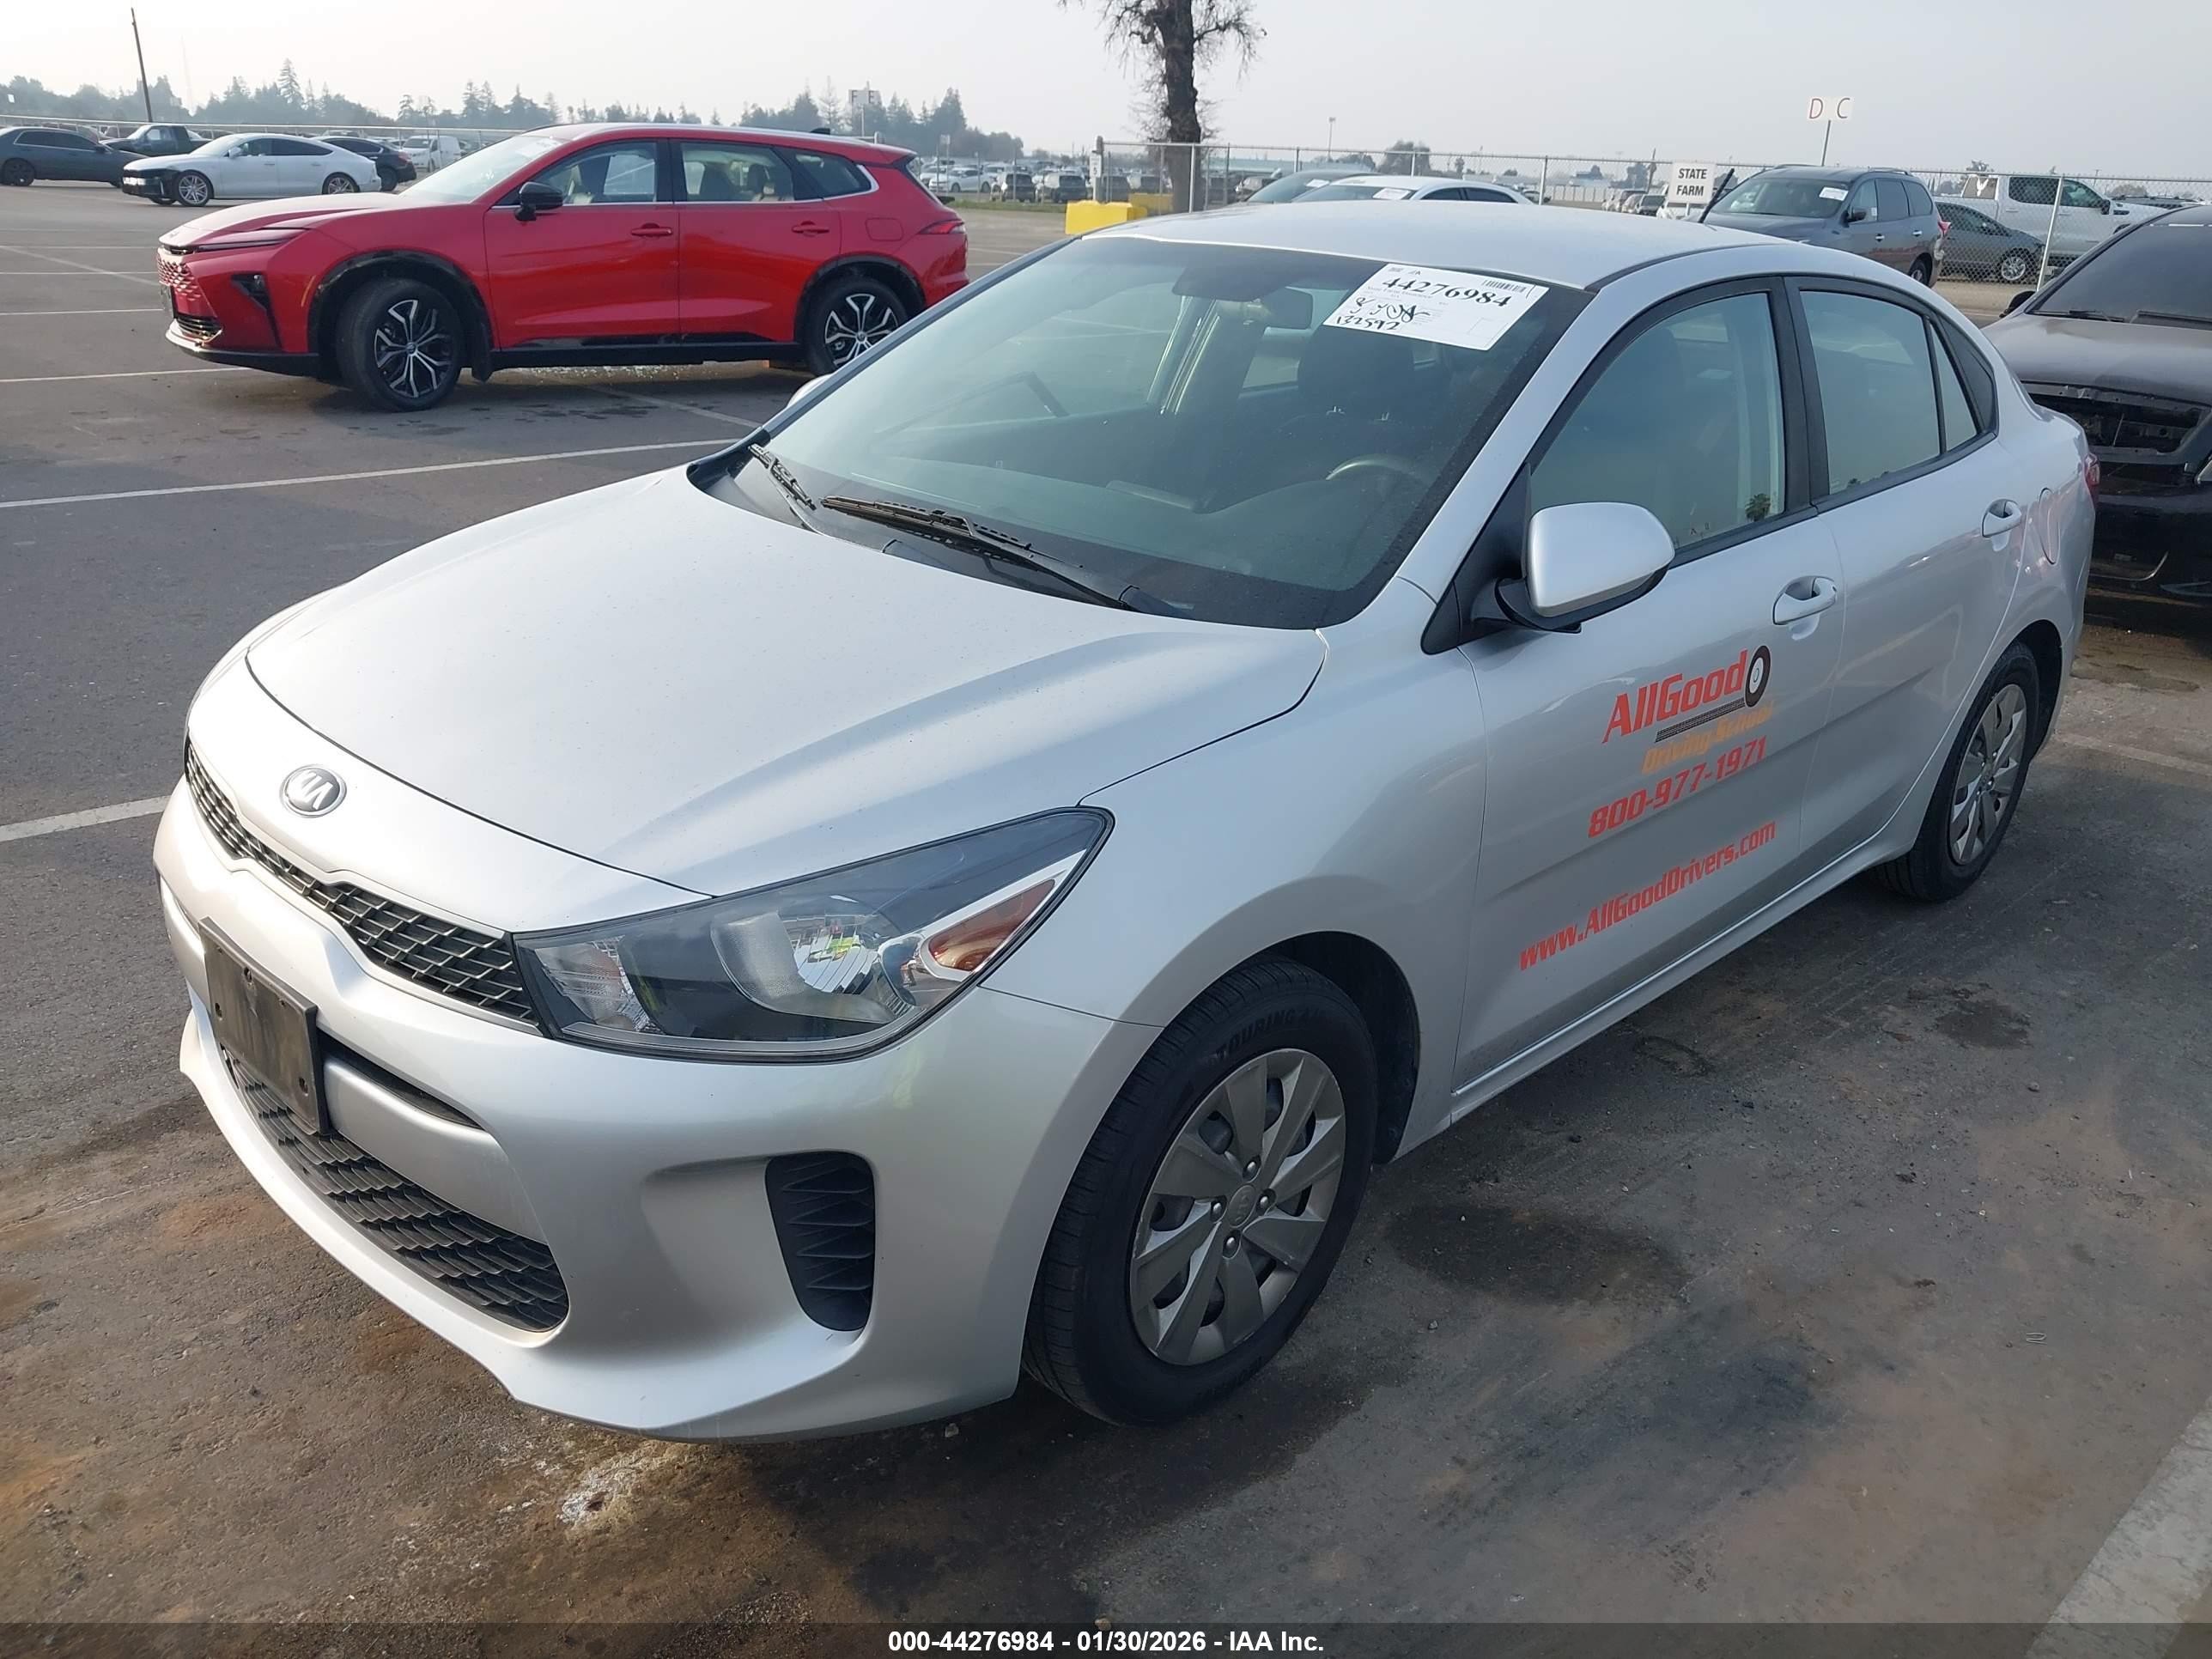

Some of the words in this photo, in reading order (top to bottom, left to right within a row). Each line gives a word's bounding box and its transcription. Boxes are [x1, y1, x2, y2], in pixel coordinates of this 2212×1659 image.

[1808, 98, 1824, 119] D
[1837, 97, 1850, 118] C
[1678, 168, 1707, 179] STATE
[1676, 185, 1705, 197] FARM
[1382, 277, 1513, 307] 44276984
[1601, 649, 1748, 744] AllGood
[1588, 735, 1767, 838] 800-977-1971
[1519, 820, 1777, 971] www.AllGoodDrivers.com
